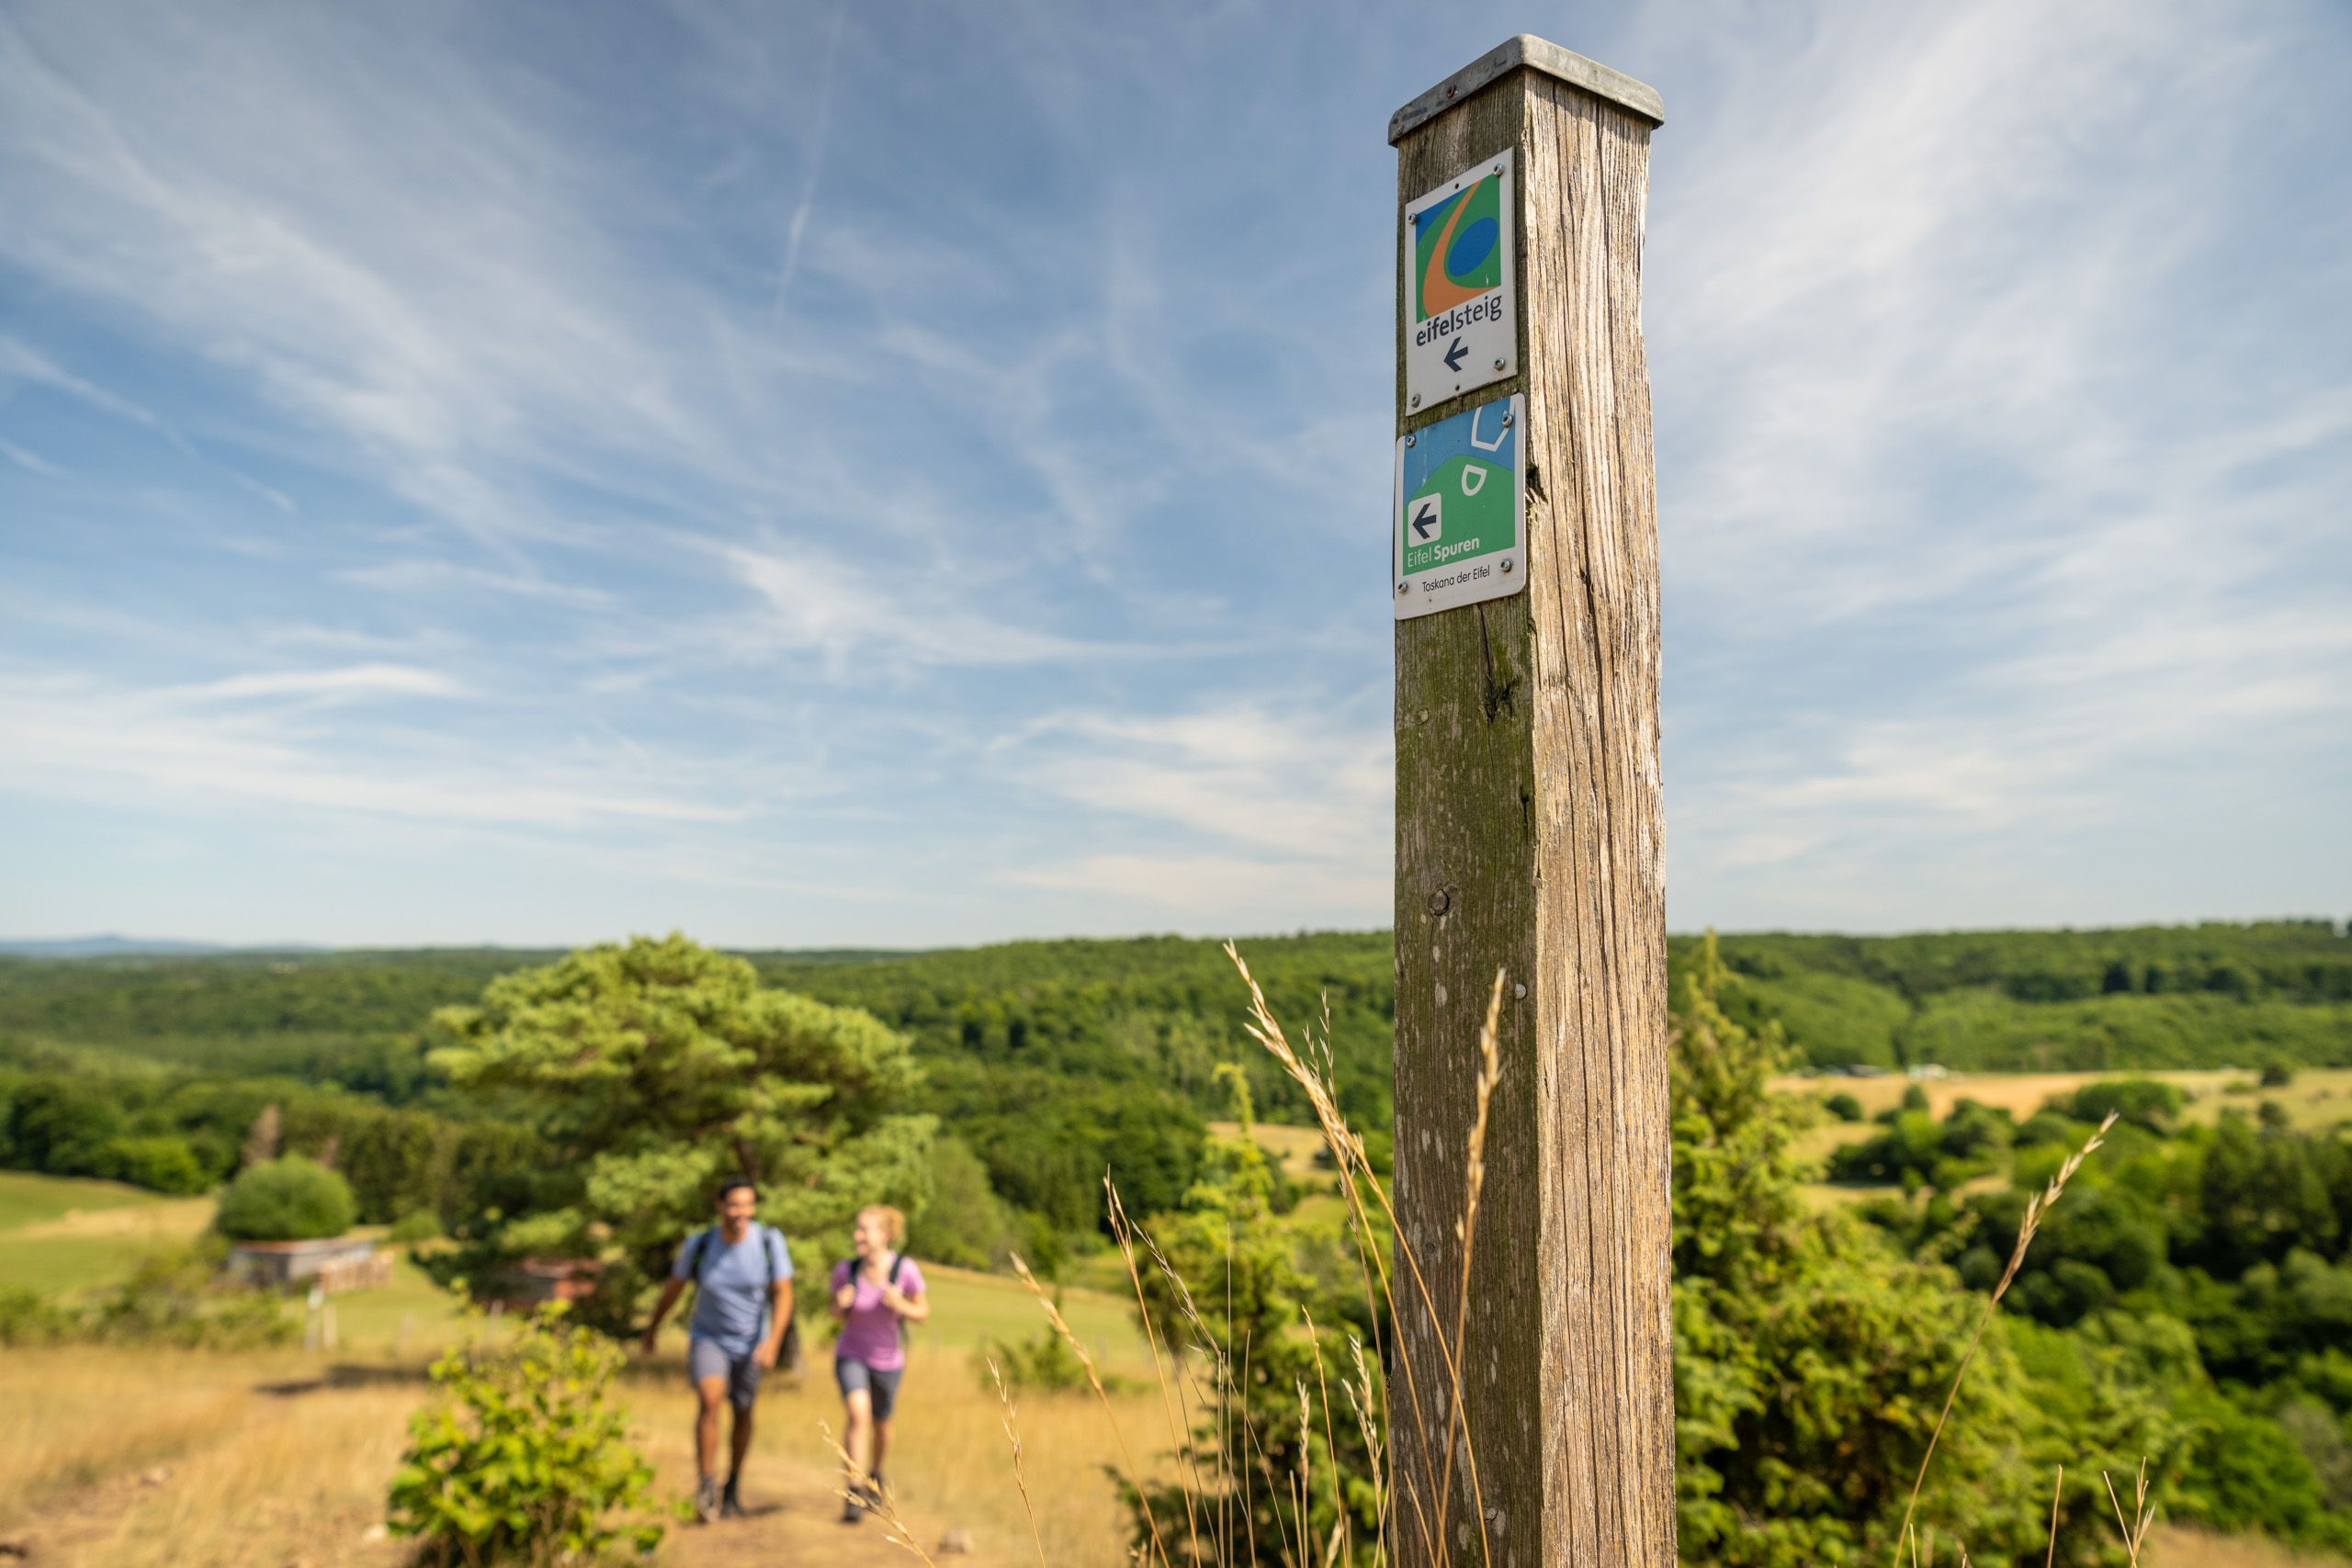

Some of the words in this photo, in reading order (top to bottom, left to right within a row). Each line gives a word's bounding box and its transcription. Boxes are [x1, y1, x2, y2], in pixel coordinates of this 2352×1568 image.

[1416, 295, 1502, 346] eifelsteig
[1422, 577, 1454, 592] Toskana
[1457, 571, 1471, 584] der
[1473, 564, 1490, 580] Eifel
